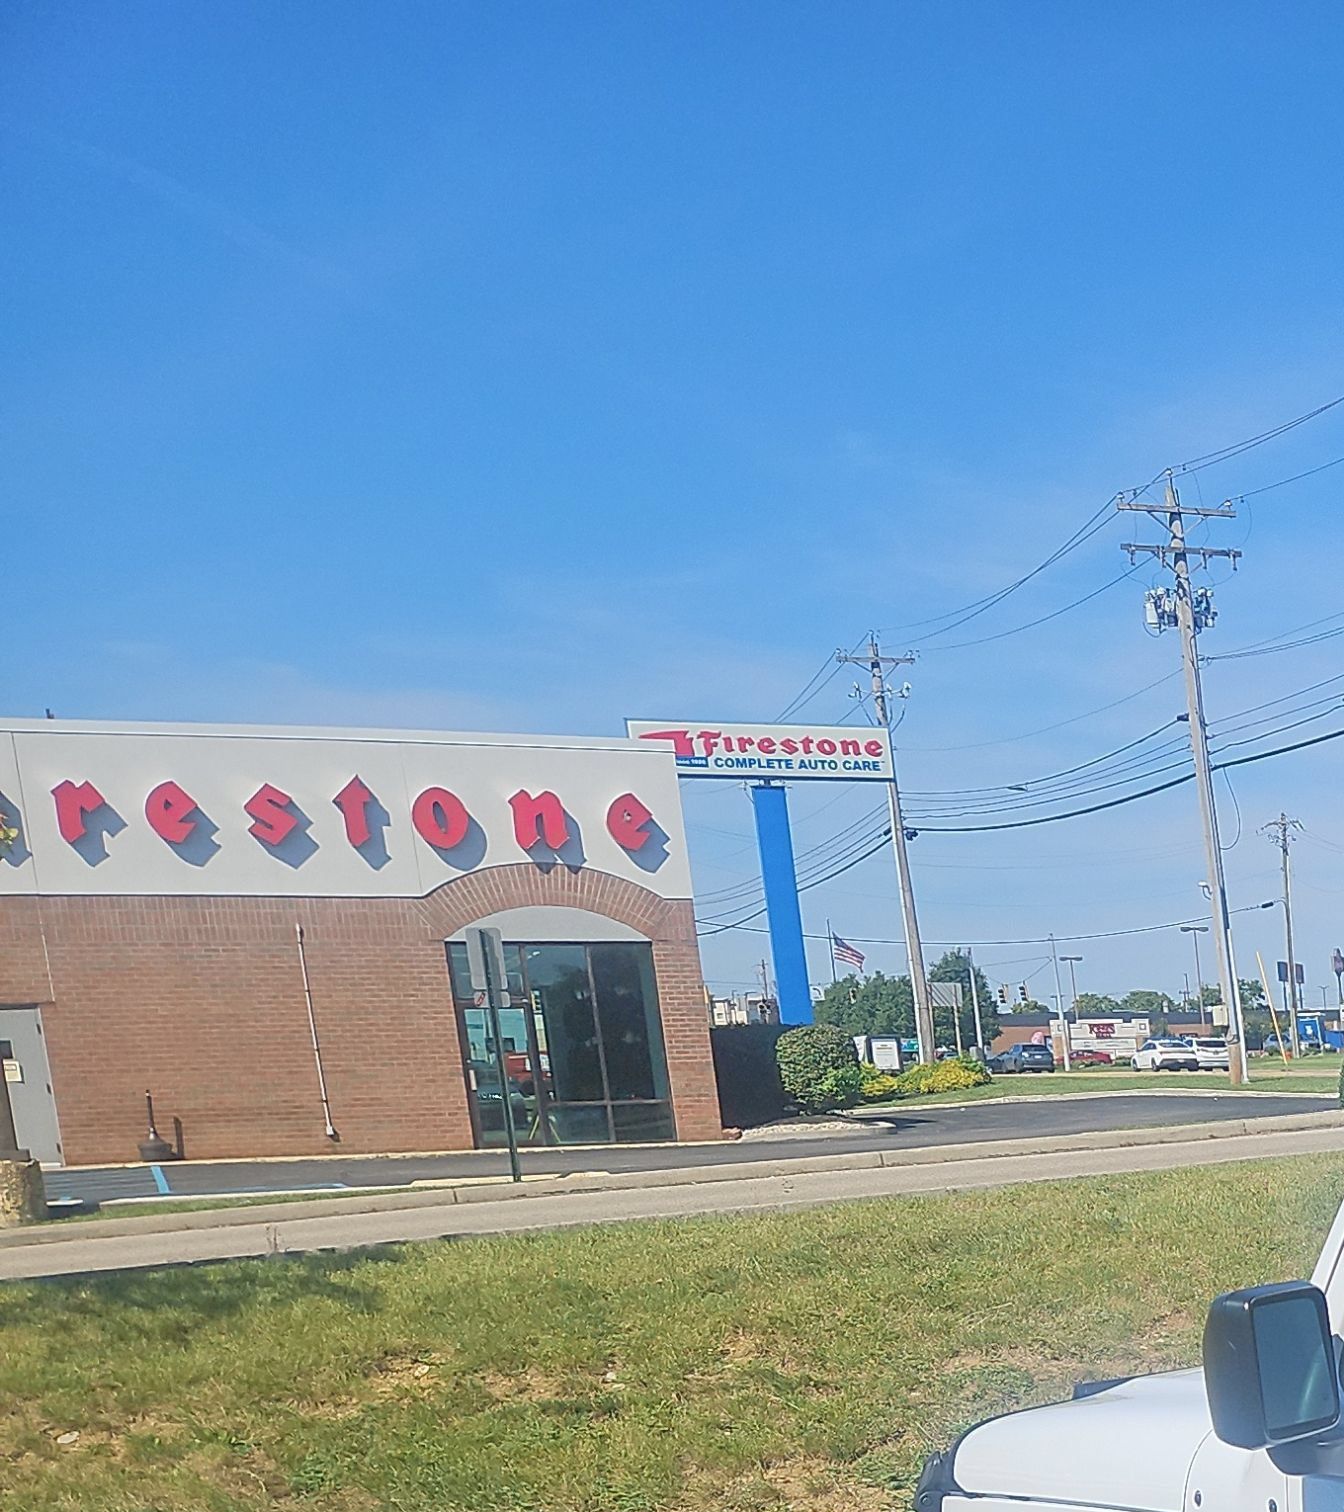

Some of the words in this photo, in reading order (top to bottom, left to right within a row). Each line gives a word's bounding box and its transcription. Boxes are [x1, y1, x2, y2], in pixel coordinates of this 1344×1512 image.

[697, 731, 884, 757] Firestone
[714, 757, 794, 770] COMPLETE
[799, 759, 838, 771] AUTO
